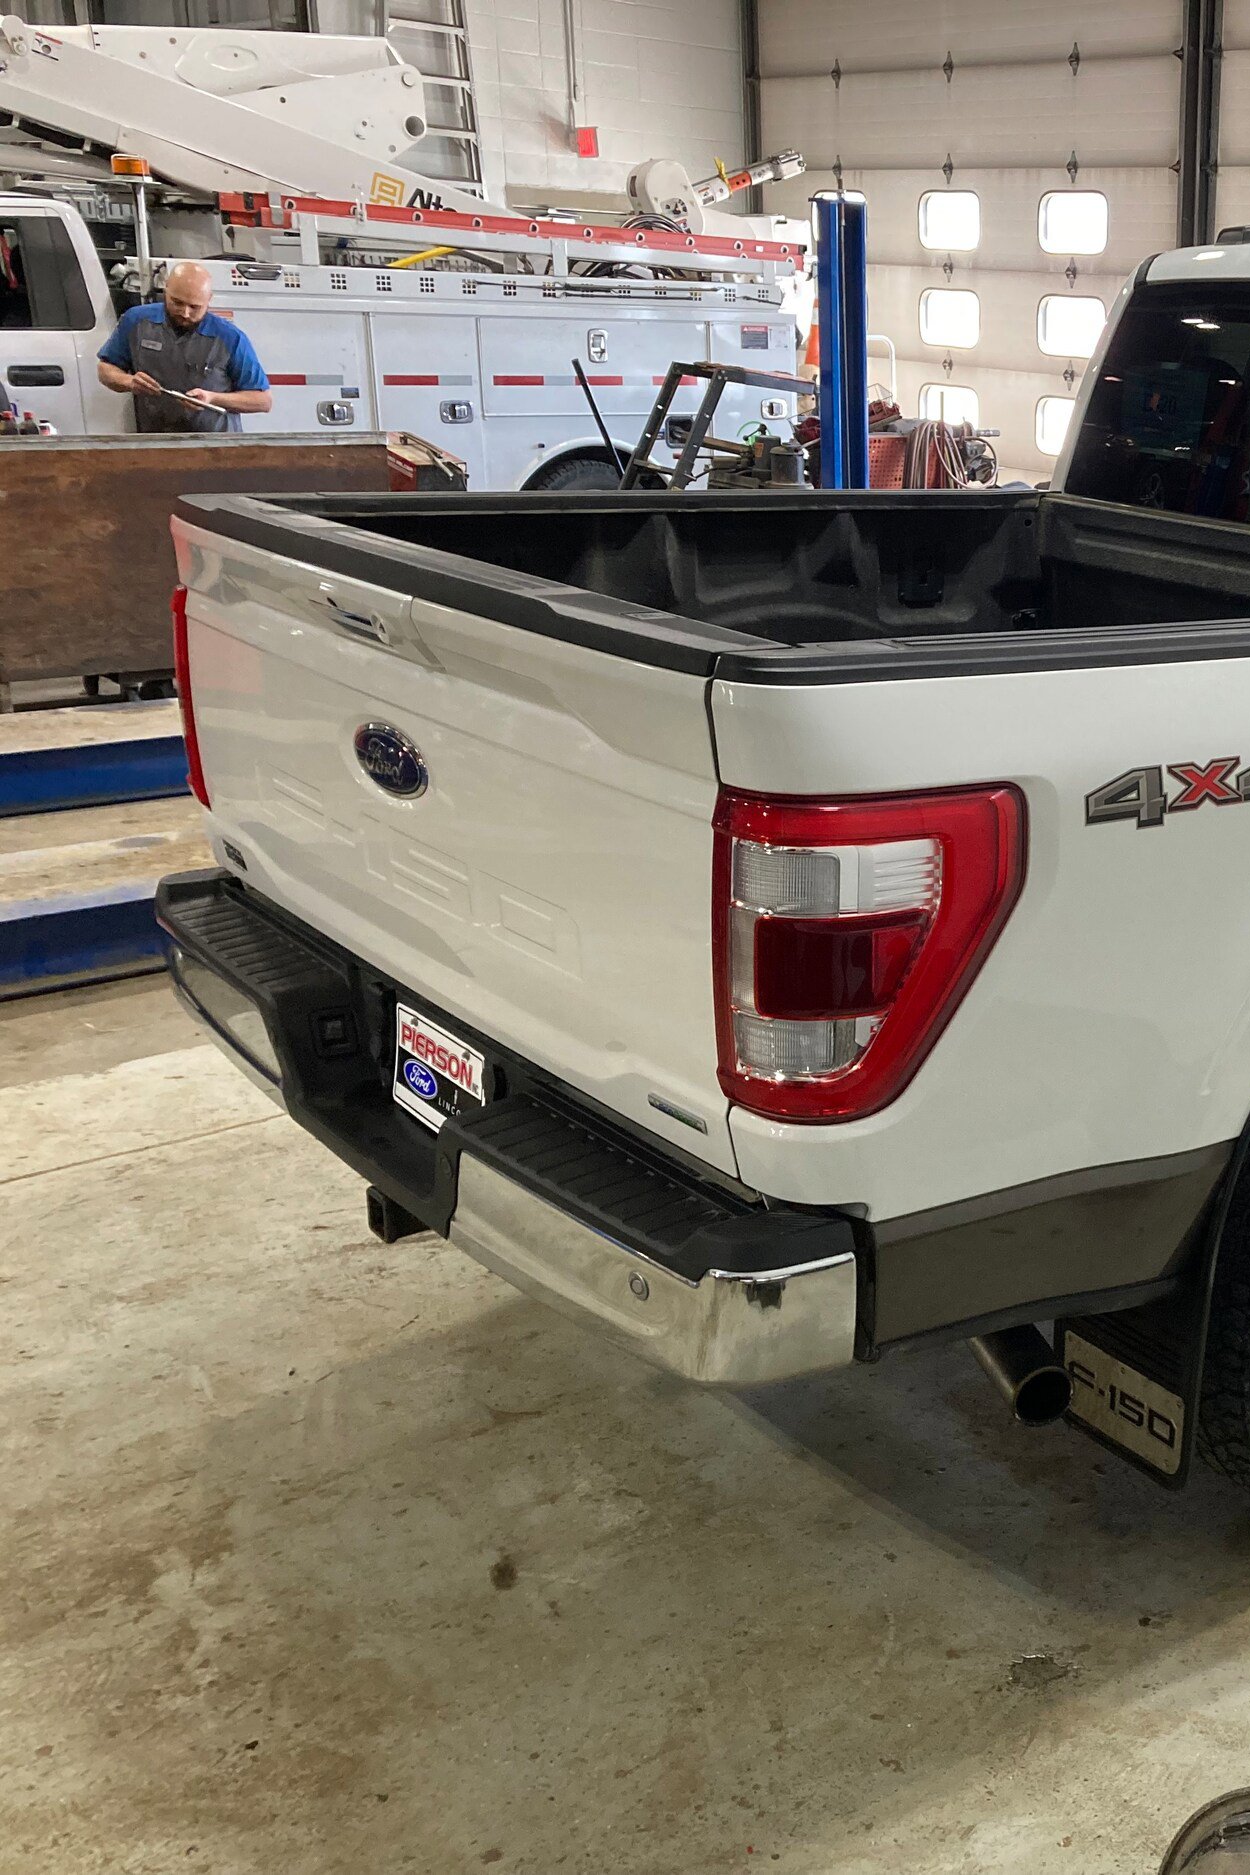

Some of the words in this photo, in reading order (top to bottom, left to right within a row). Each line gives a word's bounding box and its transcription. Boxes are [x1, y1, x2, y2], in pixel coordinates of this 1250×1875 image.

[406, 187, 457, 212] Alt
[366, 737, 405, 786] Ford
[409, 1064, 431, 1093] Ford
[438, 1096, 461, 1117] LINCO
[1067, 1360, 1176, 1449] F-150
